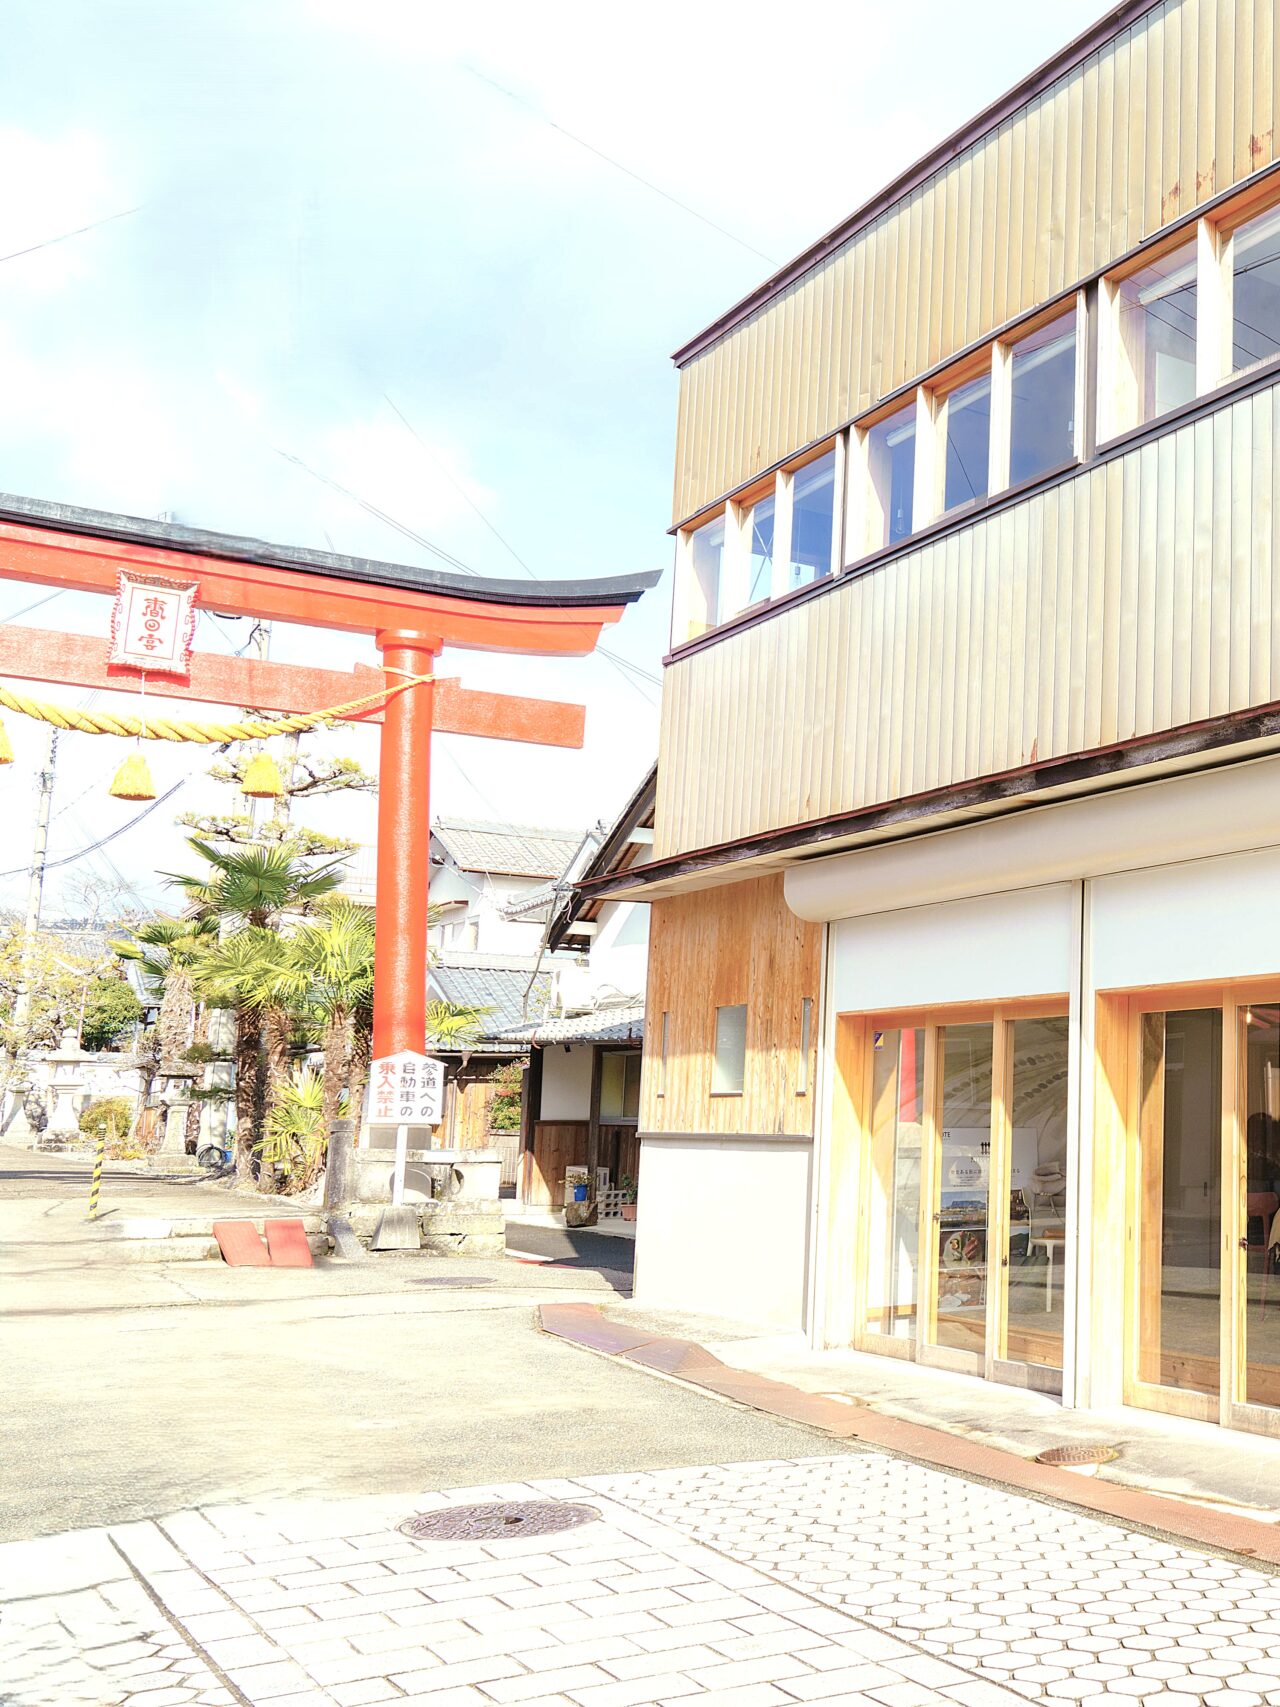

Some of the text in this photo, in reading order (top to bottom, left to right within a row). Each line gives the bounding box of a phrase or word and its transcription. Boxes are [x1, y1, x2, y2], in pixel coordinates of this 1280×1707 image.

[376, 1061, 396, 1118] 乗入禁止
[400, 1062, 416, 1117] 自動車の
[420, 1062, 438, 1117] 参道への
